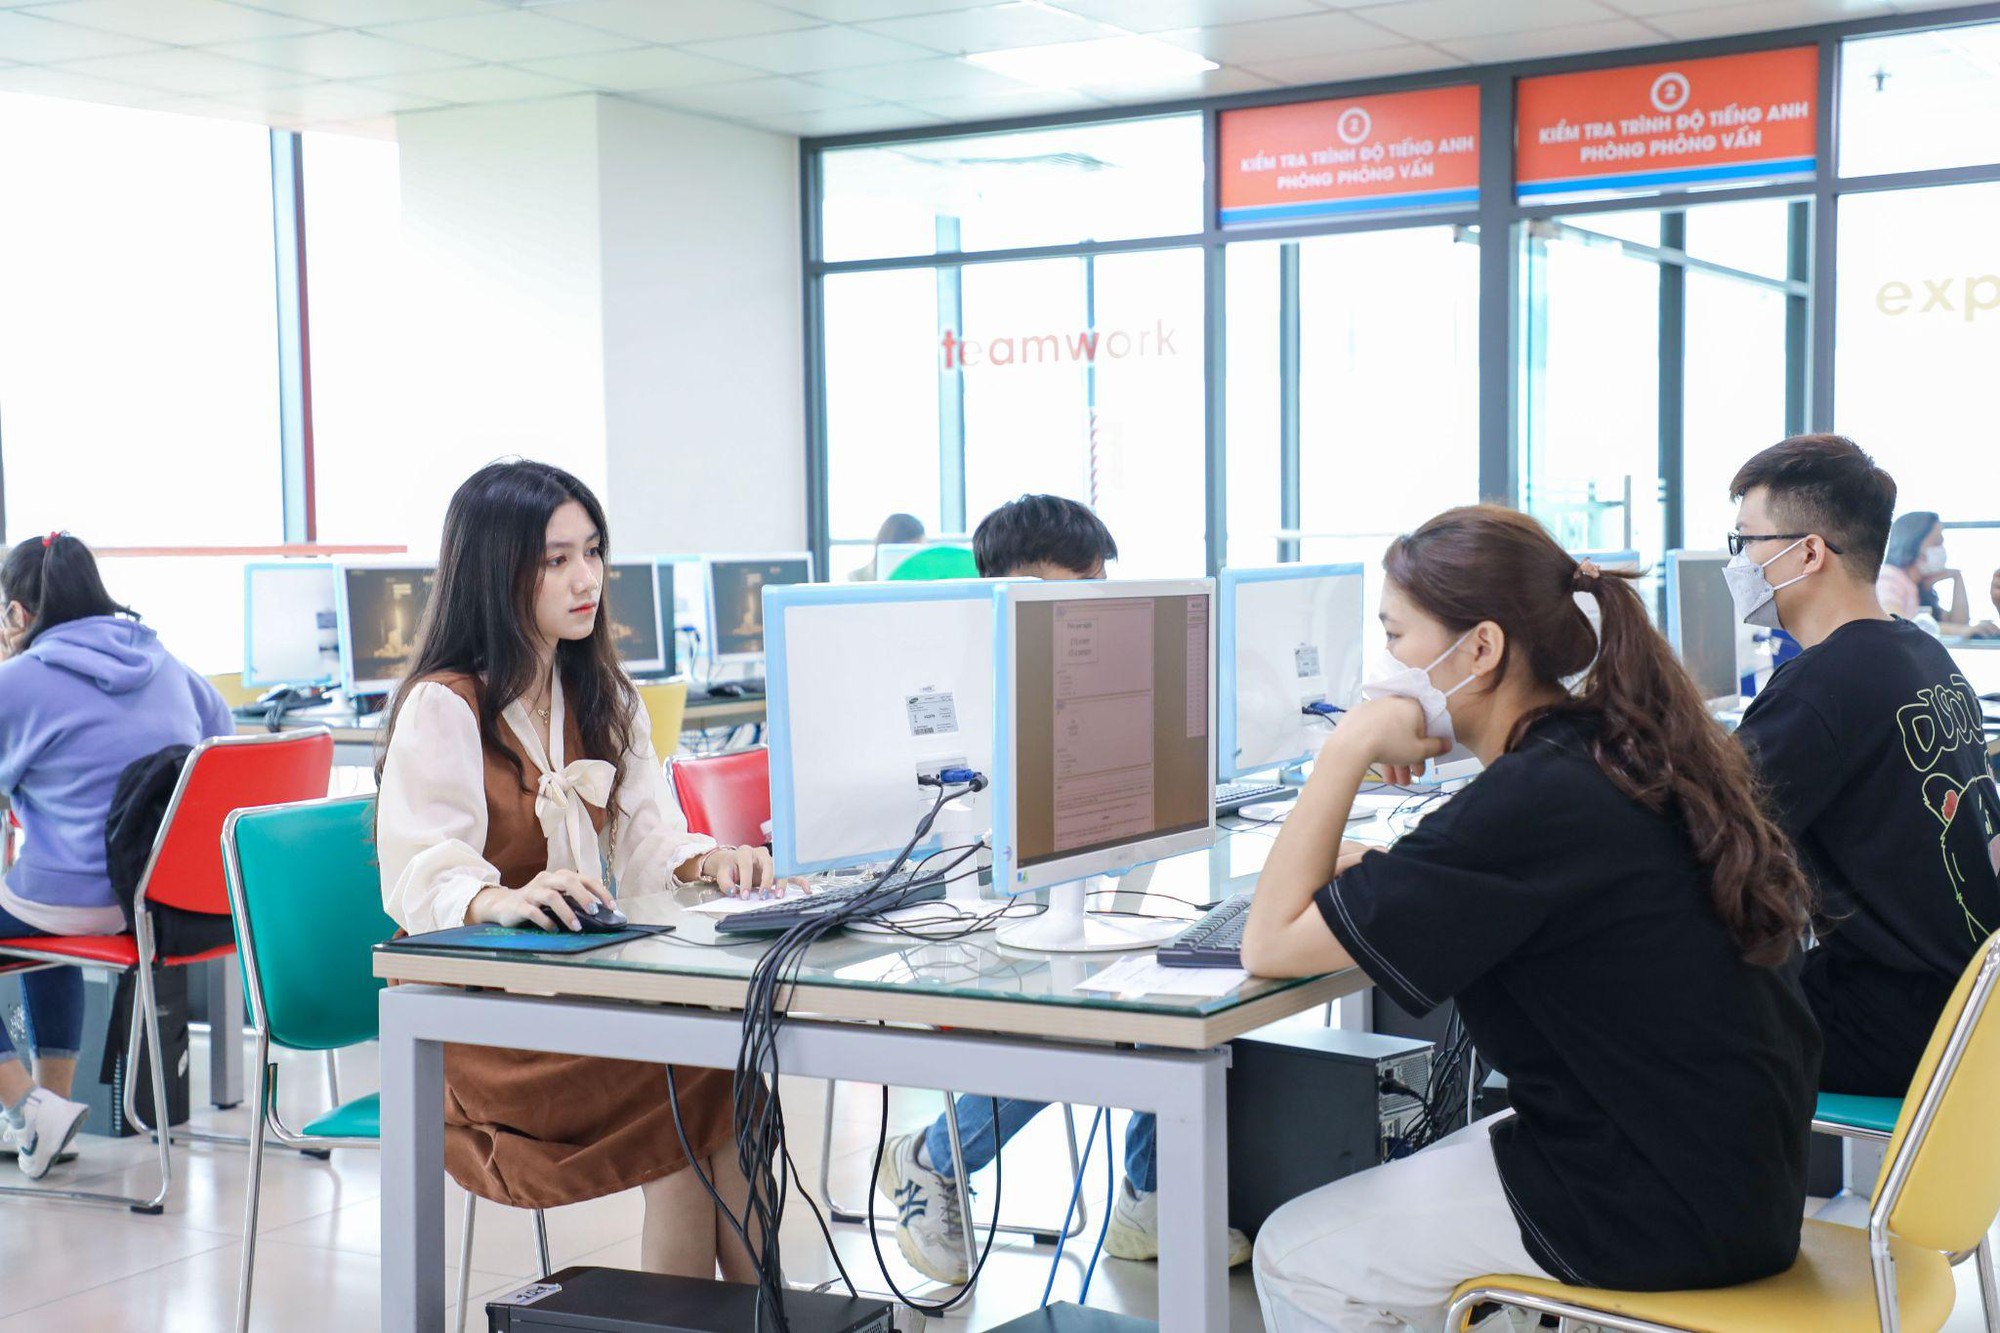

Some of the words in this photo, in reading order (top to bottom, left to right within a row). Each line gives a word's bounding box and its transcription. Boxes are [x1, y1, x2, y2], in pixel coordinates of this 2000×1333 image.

[1583, 122, 1616, 141] TRA
[1619, 114, 1671, 137] TRÌNH
[1675, 108, 1705, 132] ĐỘ
[1709, 103, 1762, 127] TIẾNG
[1766, 101, 1809, 123] ANH
[1721, 124, 1762, 149] VẤN
[1280, 153, 1308, 168] TRA
[1311, 147, 1356, 166] TRÌNH
[1438, 136, 1474, 154] ANH
[1875, 274, 2000, 322] exp
[942, 319, 1177, 368] teamwork
